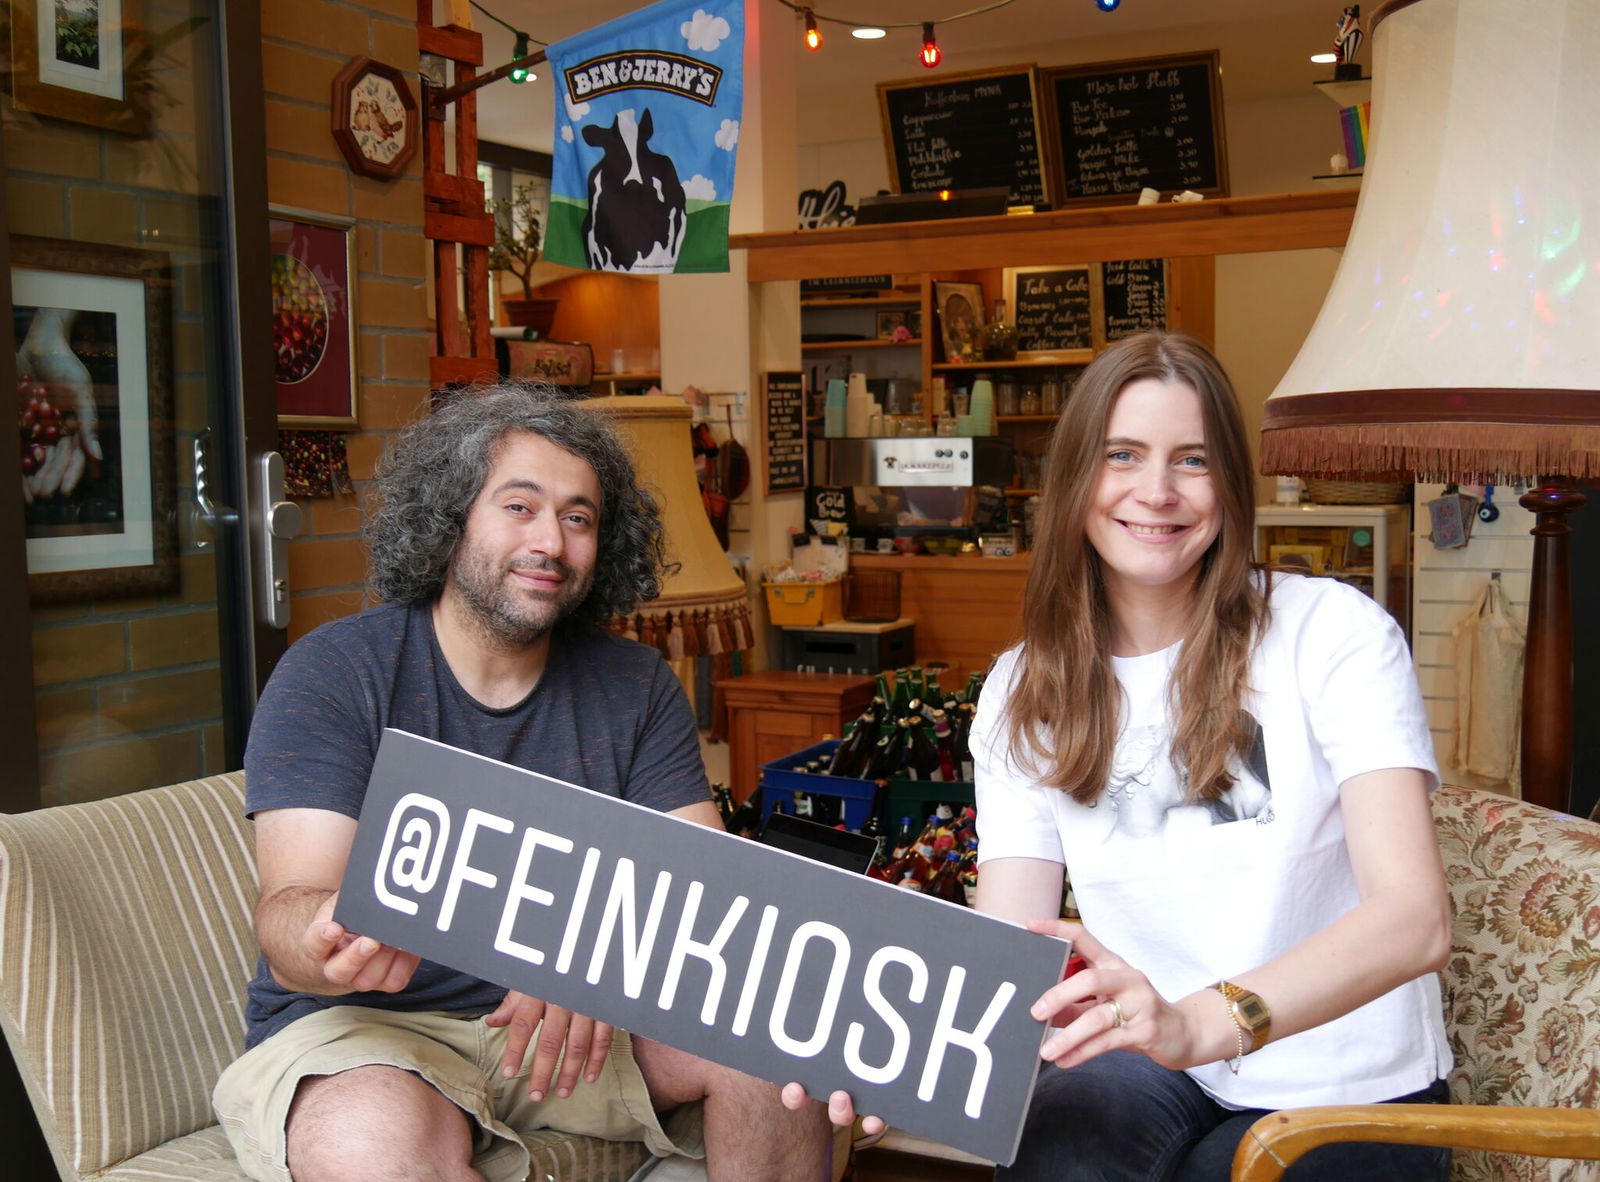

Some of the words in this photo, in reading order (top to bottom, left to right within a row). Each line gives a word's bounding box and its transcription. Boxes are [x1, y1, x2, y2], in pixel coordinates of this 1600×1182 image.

[816, 492, 845, 509] Cold
[818, 503, 847, 518] Brew
[375, 793, 1016, 1118] @FEINKIOSK
